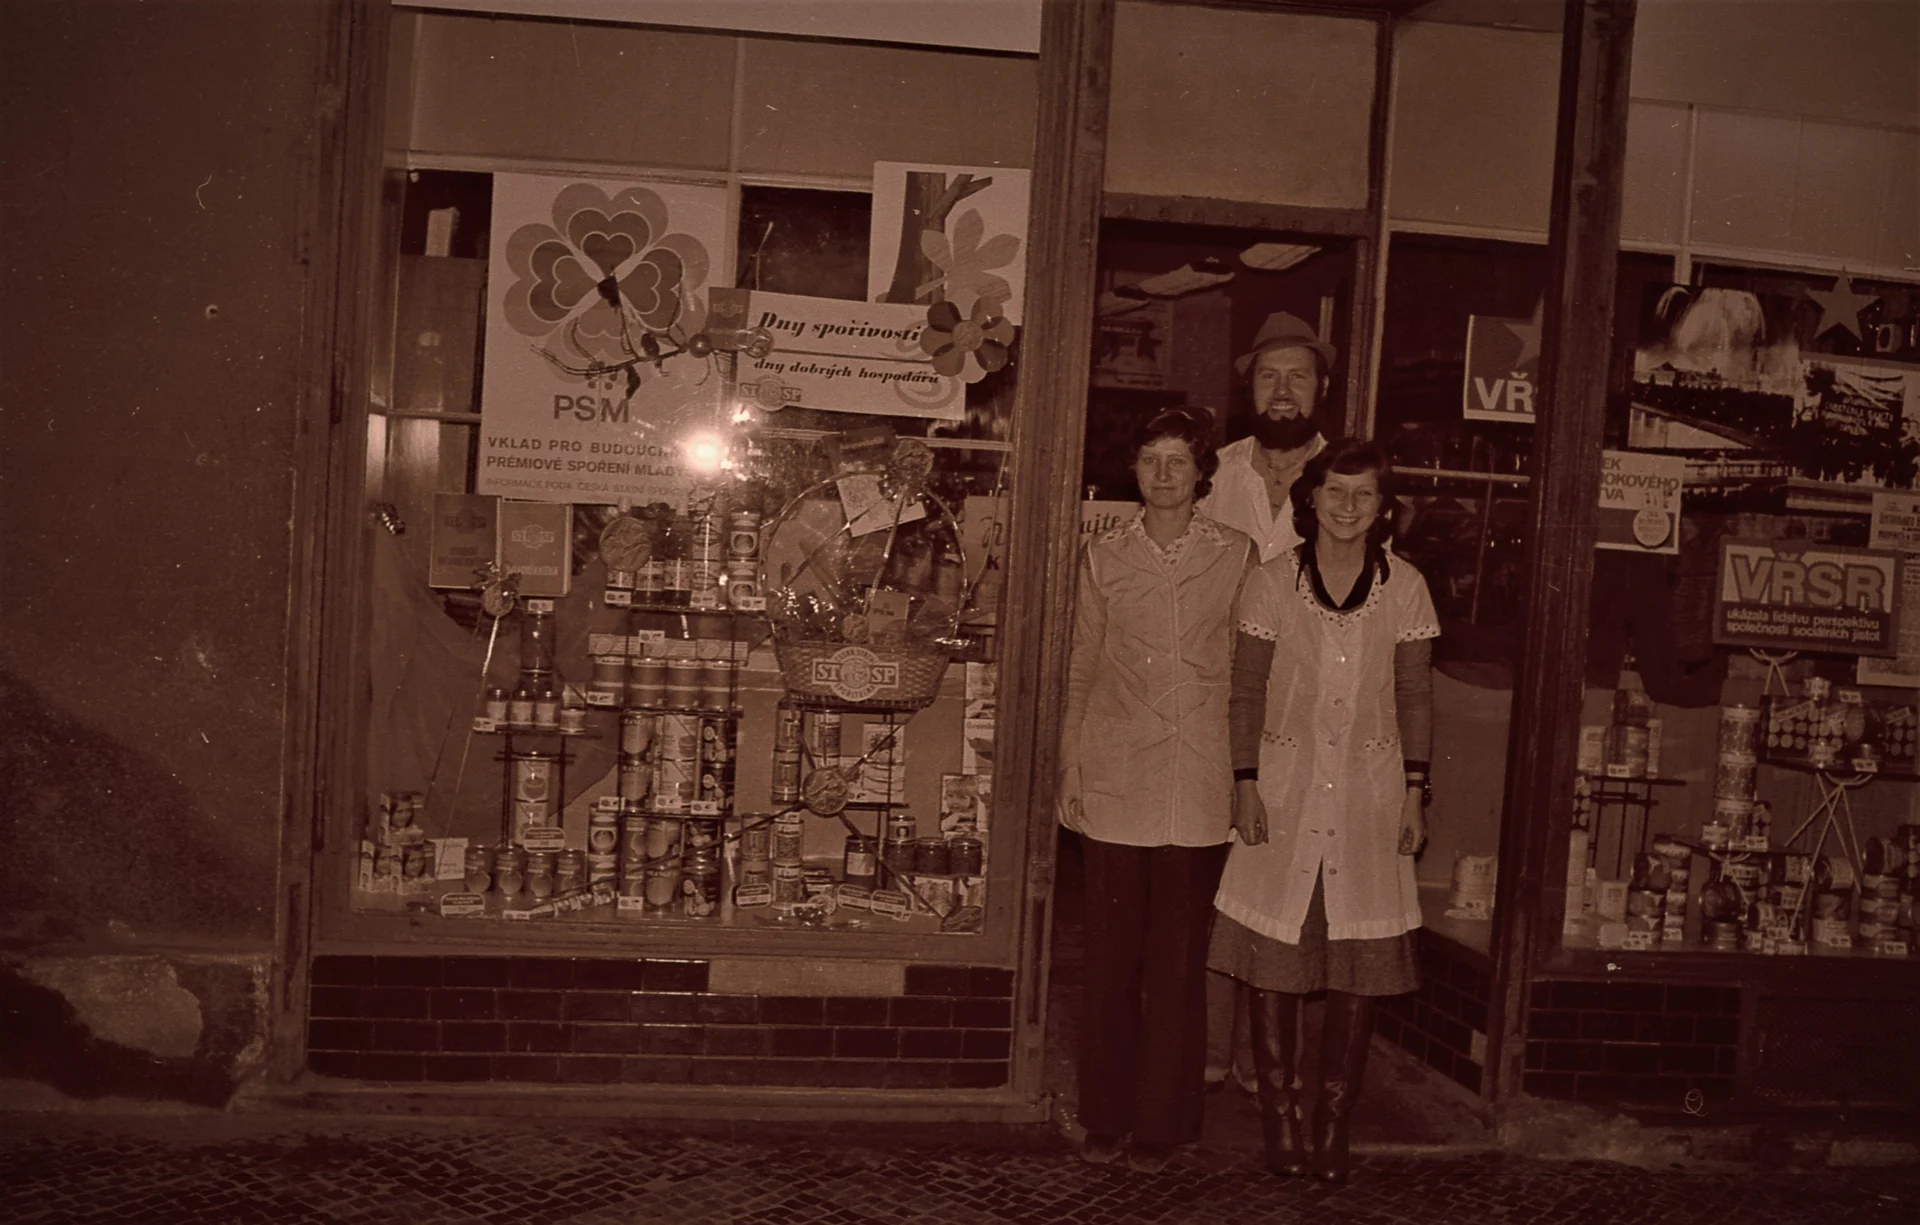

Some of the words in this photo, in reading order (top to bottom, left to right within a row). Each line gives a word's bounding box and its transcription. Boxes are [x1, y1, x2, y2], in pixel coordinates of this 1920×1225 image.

[758, 311, 807, 338] Dny
[754, 357, 785, 374] dny
[789, 360, 852, 379] dobrých
[1474, 371, 1535, 413] VŘ
[553, 394, 630, 424] PSM
[487, 436, 542, 450] VKLAD
[549, 440, 582, 452] PRO
[486, 455, 562, 471] PRÉMIOVÉ
[567, 459, 631, 475] SPOŘENÍ
[1731, 552, 1885, 610] VŘSR
[1726, 608, 1769, 621] ukázala
[1773, 611, 1809, 625] lidstvu
[1813, 614, 1880, 630] perspektivu
[1726, 621, 1789, 637] společnosti
[816, 663, 841, 681] ST
[871, 667, 895, 683] SP
